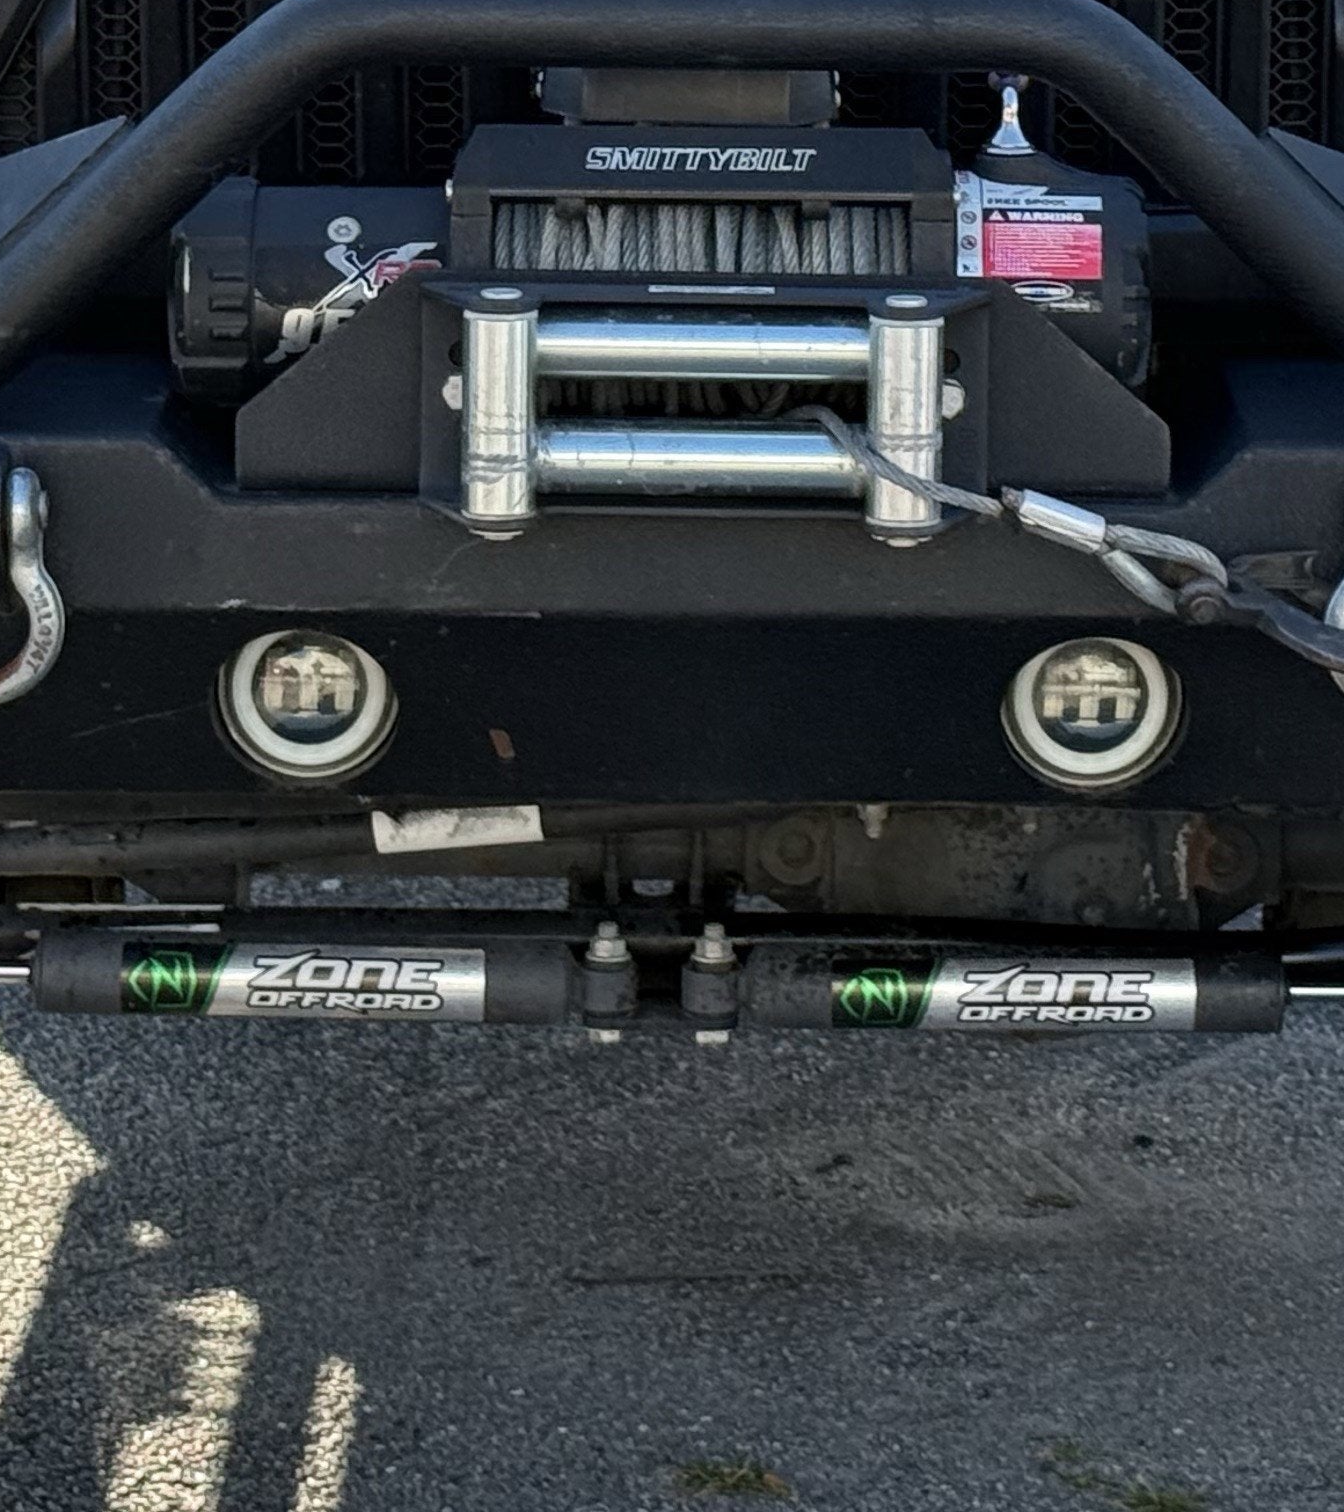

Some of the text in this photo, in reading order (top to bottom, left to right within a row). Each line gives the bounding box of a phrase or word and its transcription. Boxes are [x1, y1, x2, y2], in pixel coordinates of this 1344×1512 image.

[585, 146, 817, 172] SMITTYBILT
[1006, 210, 1084, 222] WARNING
[254, 949, 445, 990] ZONE
[959, 964, 1152, 1004] ZONE
[248, 990, 444, 1012] OFFROAD
[959, 1004, 1153, 1025] OFFROAD
